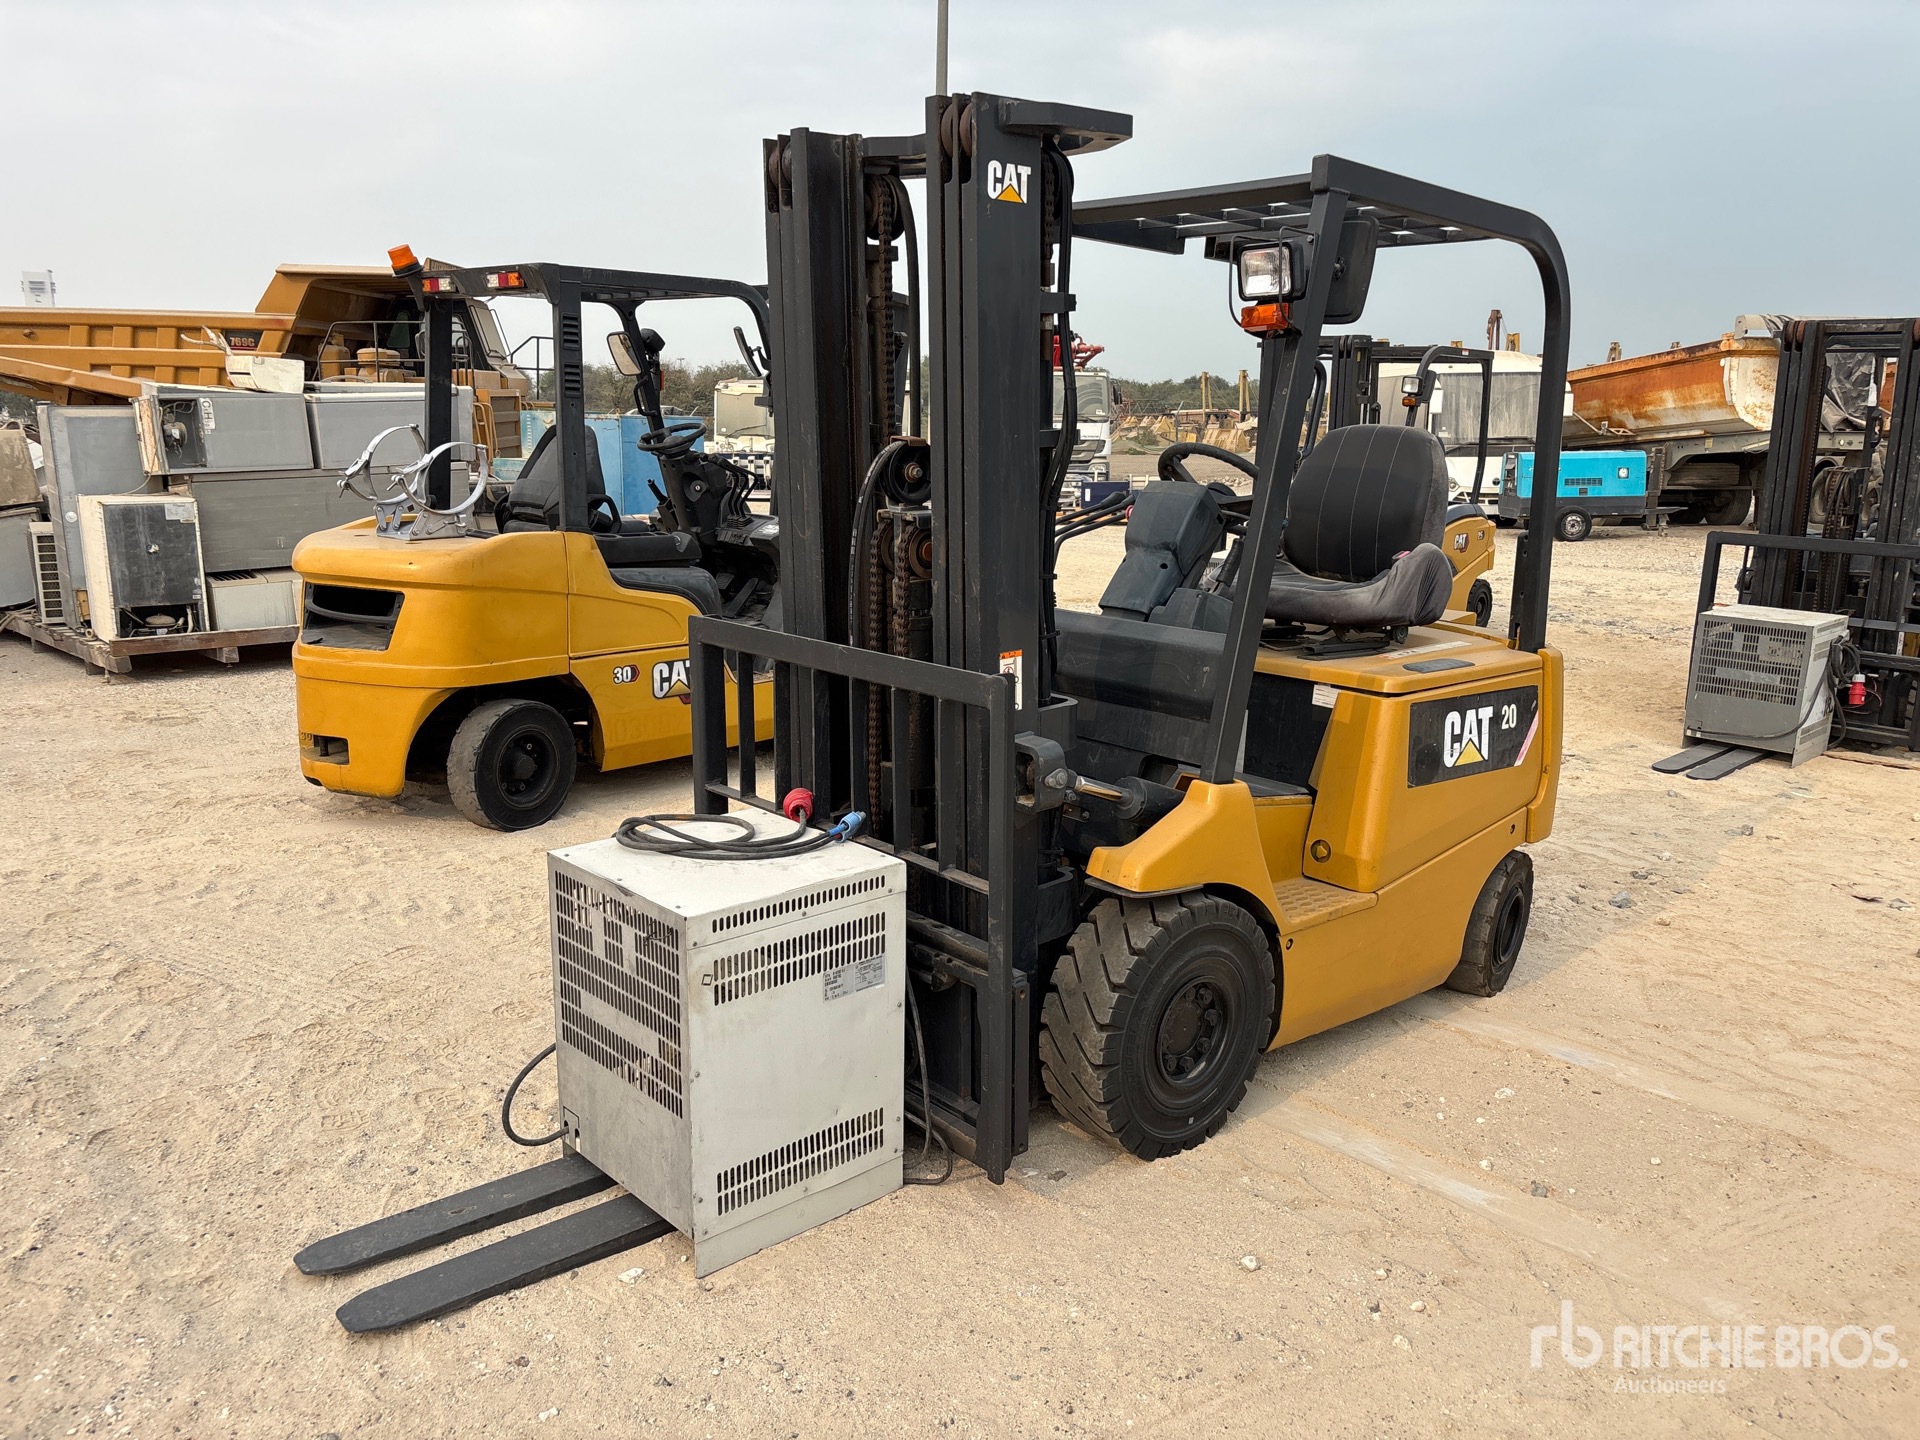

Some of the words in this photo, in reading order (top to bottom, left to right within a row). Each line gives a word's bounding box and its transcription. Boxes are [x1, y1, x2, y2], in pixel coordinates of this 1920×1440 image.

[987, 160, 1031, 204] CAT
[230, 337, 255, 347] 769C
[1454, 533, 1467, 550] CAT
[614, 666, 632, 684] 30
[653, 660, 690, 698] CA
[1443, 706, 1493, 768] CAT
[1502, 704, 1517, 729] 20
